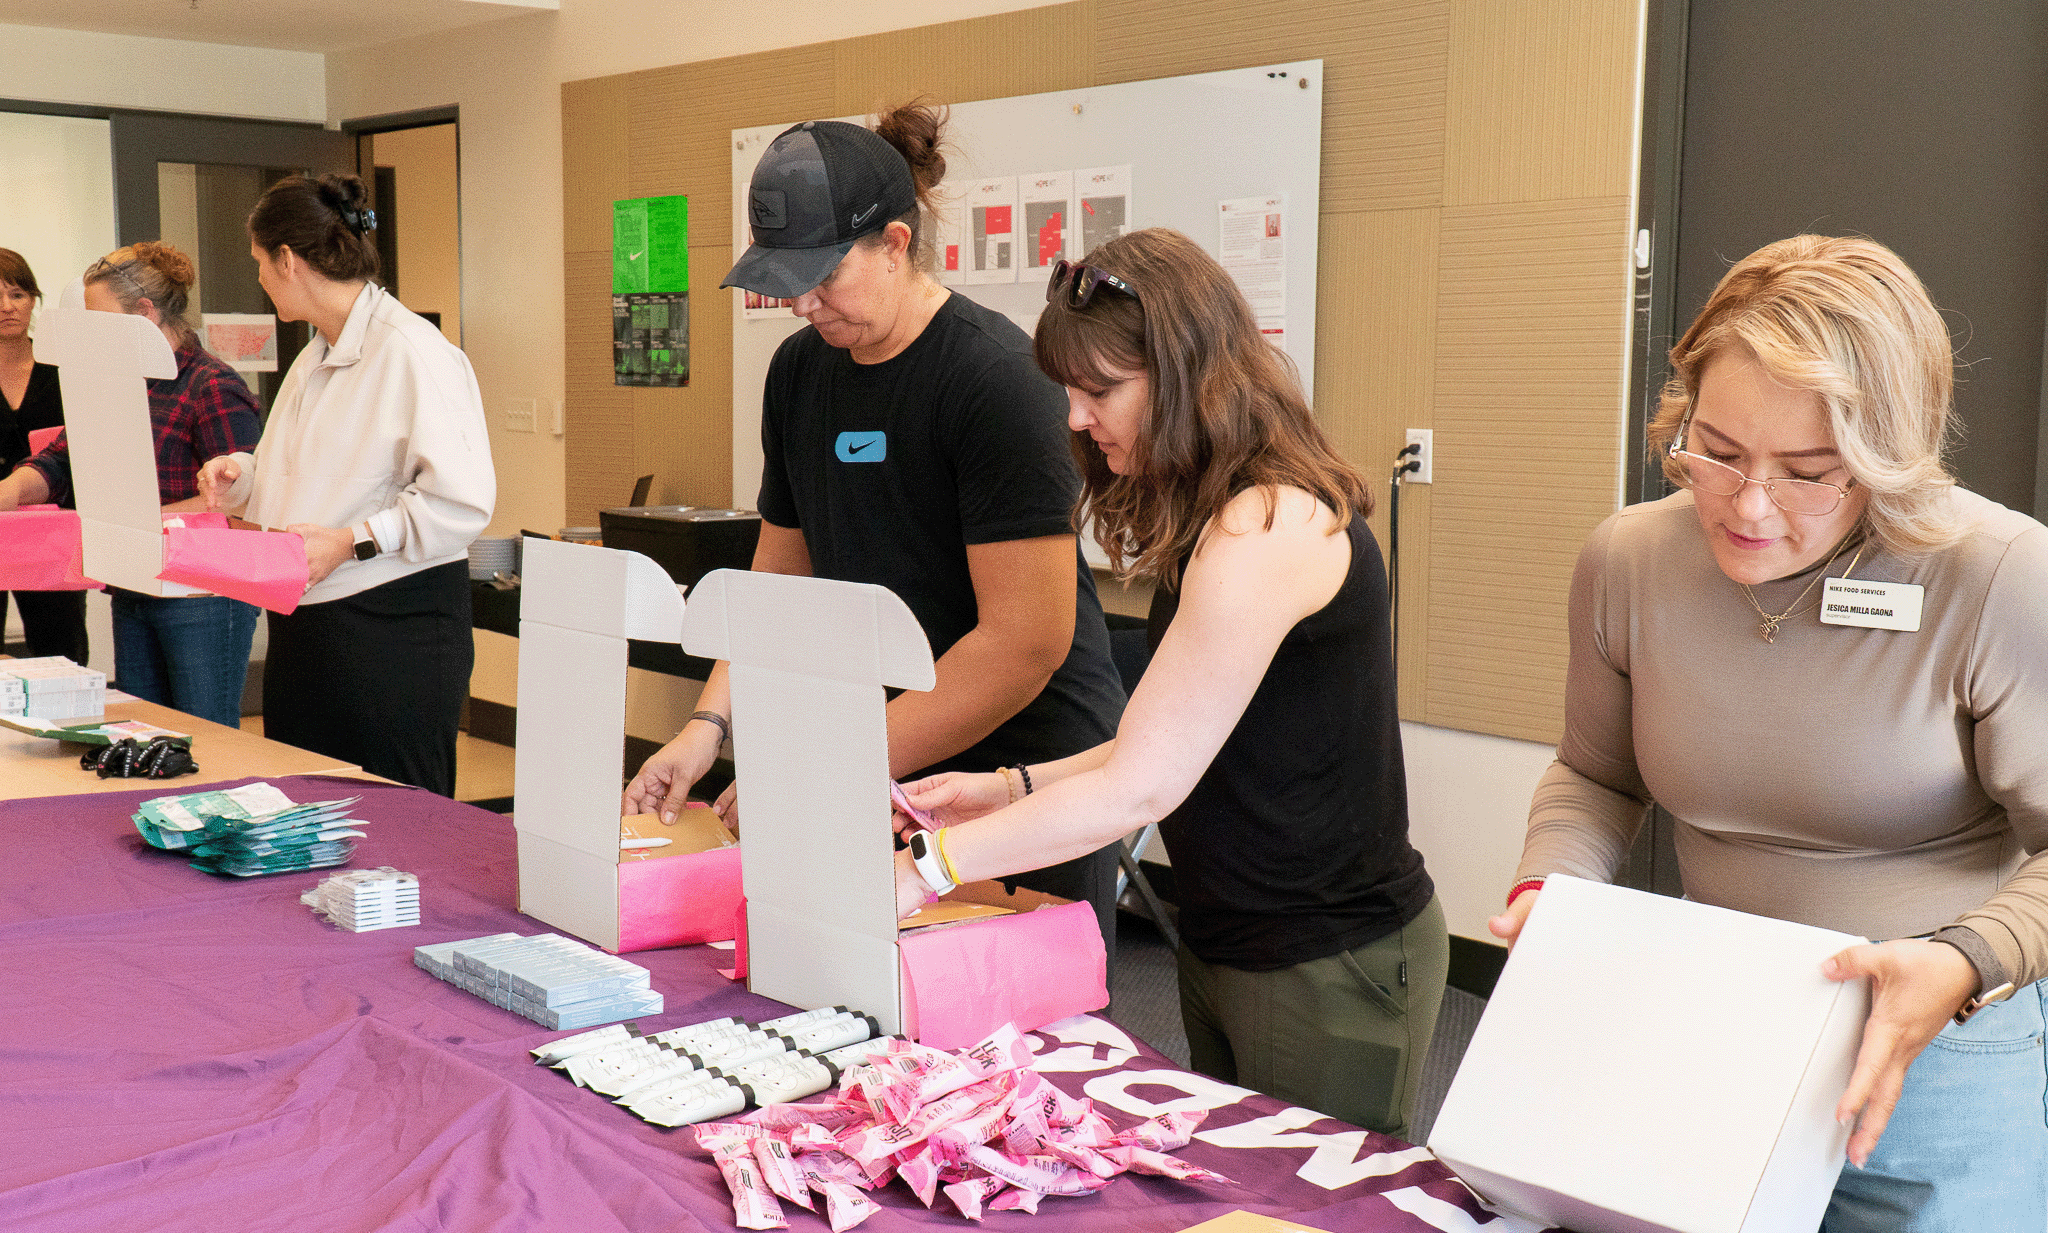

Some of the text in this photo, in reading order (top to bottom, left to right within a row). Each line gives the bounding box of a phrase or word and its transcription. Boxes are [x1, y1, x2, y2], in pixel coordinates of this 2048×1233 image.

[1827, 604, 1893, 616] JESICA MILLA GAONA
[981, 1040, 999, 1056] LE
